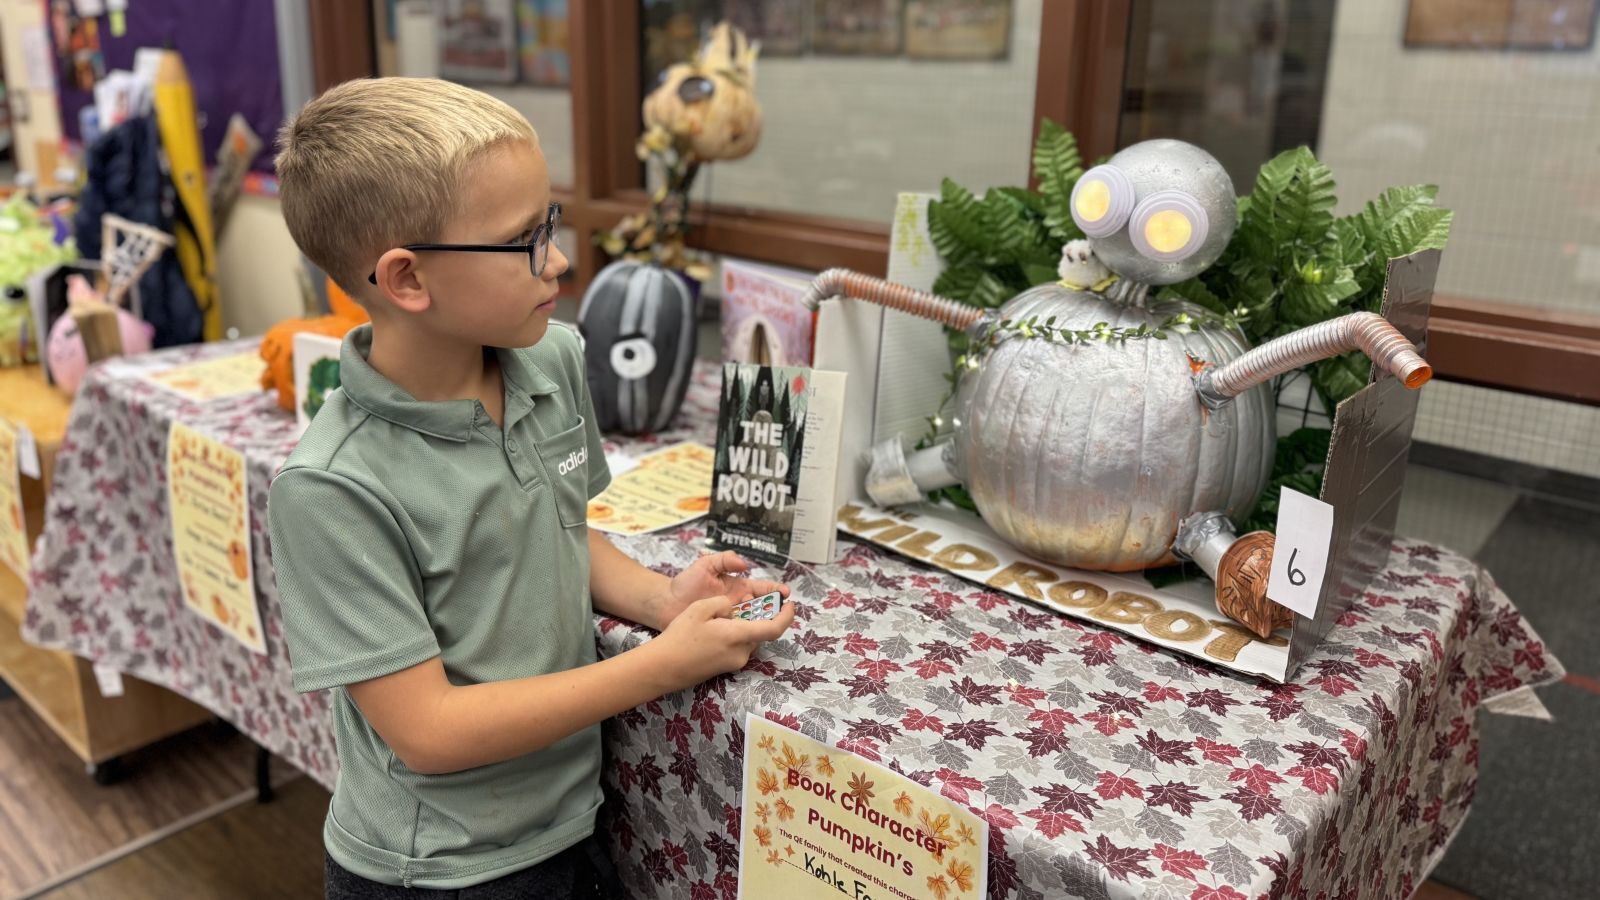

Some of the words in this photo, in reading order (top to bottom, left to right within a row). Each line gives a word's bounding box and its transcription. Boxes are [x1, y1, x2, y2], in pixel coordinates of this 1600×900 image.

[740, 421, 783, 446] THE
[728, 445, 790, 479] WILD
[717, 474, 792, 513] ROBOT
[721, 532, 751, 548] PETER
[1287, 547, 1306, 586] 6
[986, 560, 1289, 662] ROBOT
[787, 767, 837, 804] Book
[840, 792, 947, 857] Character
[779, 828, 793, 840] The
[793, 835, 803, 845] QE
[803, 839, 827, 858] family
[827, 852, 843, 866] that
[843, 862, 872, 881] created
[873, 876, 888, 890] this
[808, 807, 913, 876] Pumpkin's
[804, 852, 848, 894] Kohle
